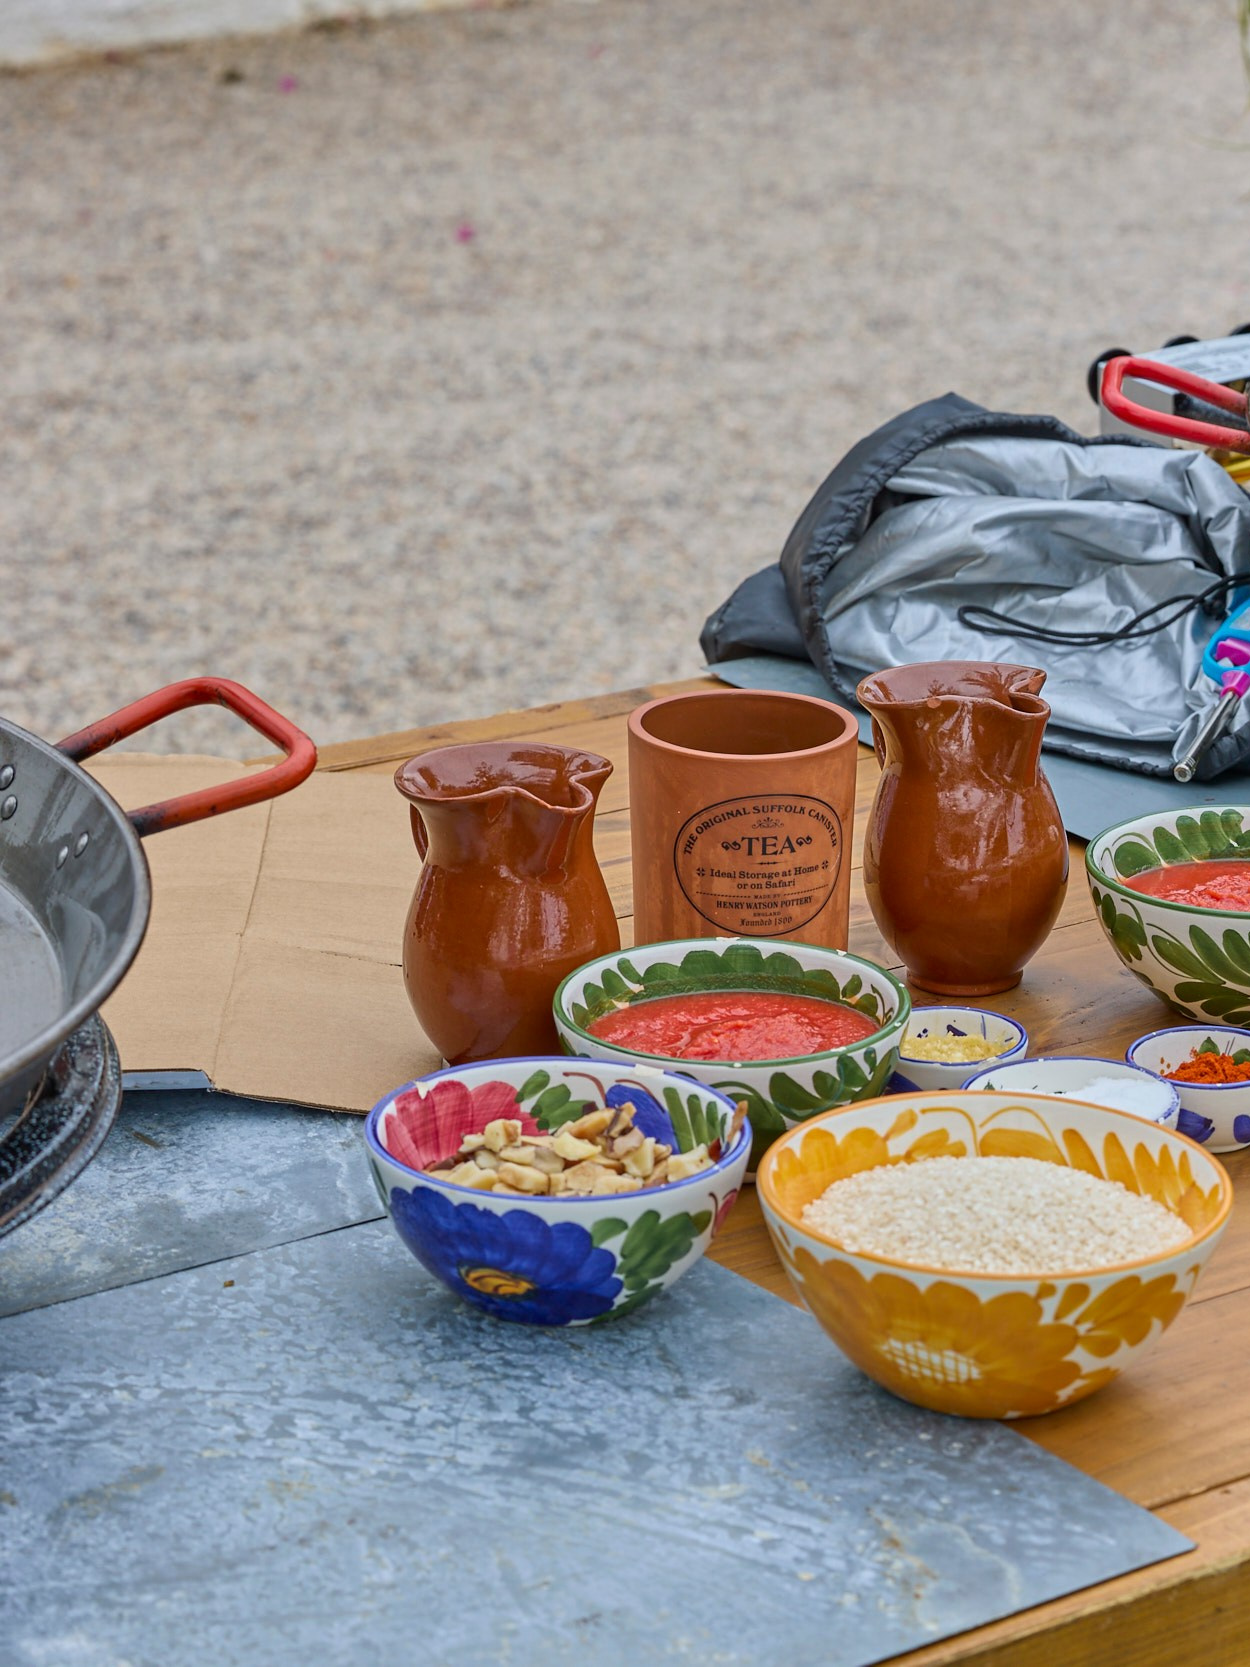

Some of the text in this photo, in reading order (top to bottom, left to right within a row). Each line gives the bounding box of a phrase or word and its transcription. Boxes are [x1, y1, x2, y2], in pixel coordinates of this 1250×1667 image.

[683, 804, 837, 855] THE ORIGINAL SUFFOLK CANISTER
[741, 835, 796, 856] TEA
[710, 864, 820, 881] Ideal Storage at Home
[750, 882, 763, 890] on
[765, 879, 796, 890] Safari
[716, 896, 813, 911] HENRY WATSON POTTERY
